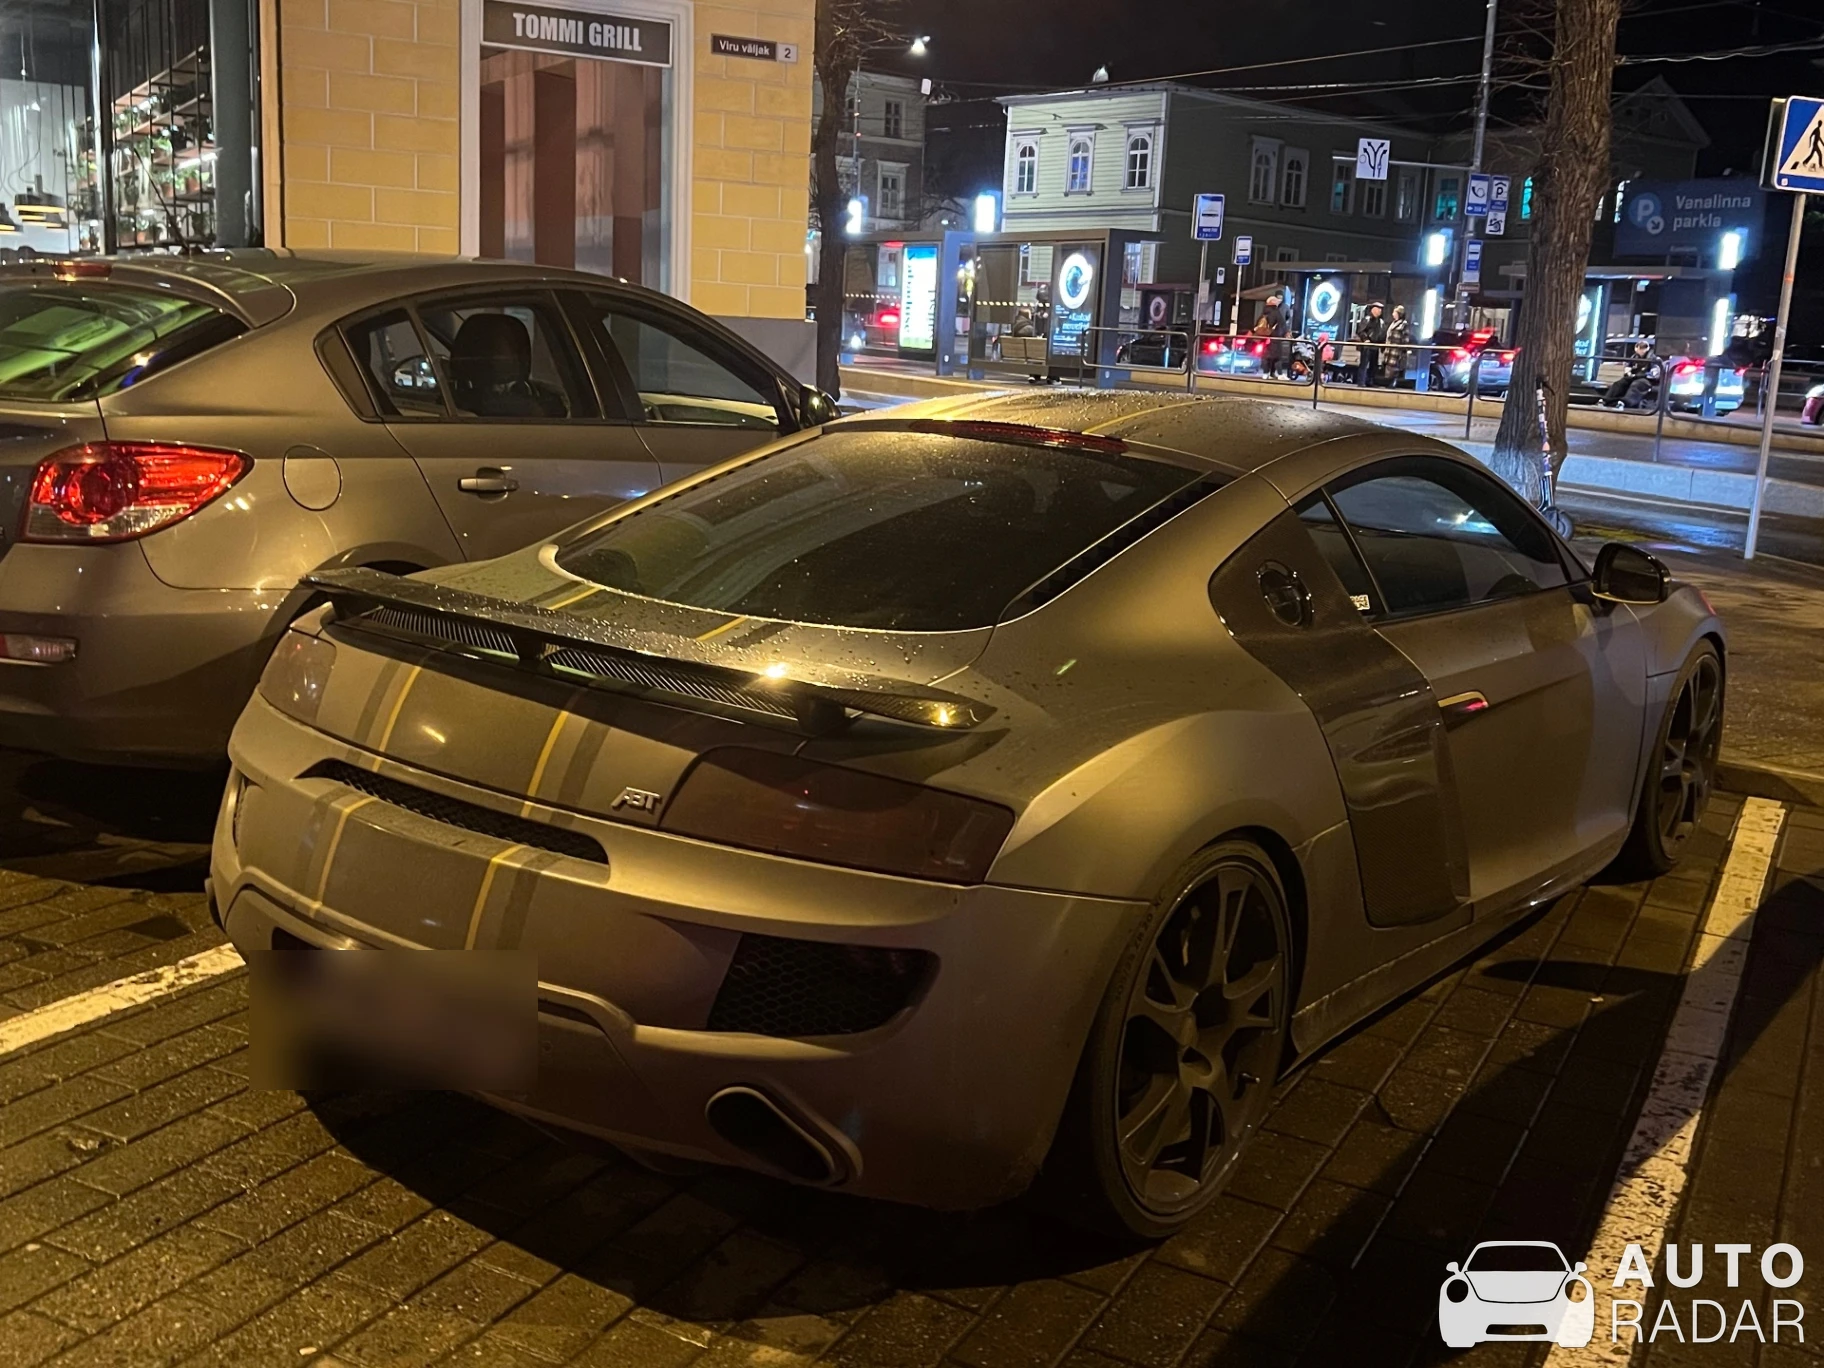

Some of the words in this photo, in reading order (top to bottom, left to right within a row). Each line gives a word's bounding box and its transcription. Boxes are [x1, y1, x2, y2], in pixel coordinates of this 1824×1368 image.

[513, 12, 584, 44] TOMMI
[588, 22, 642, 51] GRILL
[719, 40, 739, 52] Viru
[741, 43, 770, 56] väljak
[784, 47, 791, 59] 2
[1676, 194, 1751, 210] Vanalinna
[1673, 213, 1722, 231] parkla
[611, 786, 660, 809] ABT
